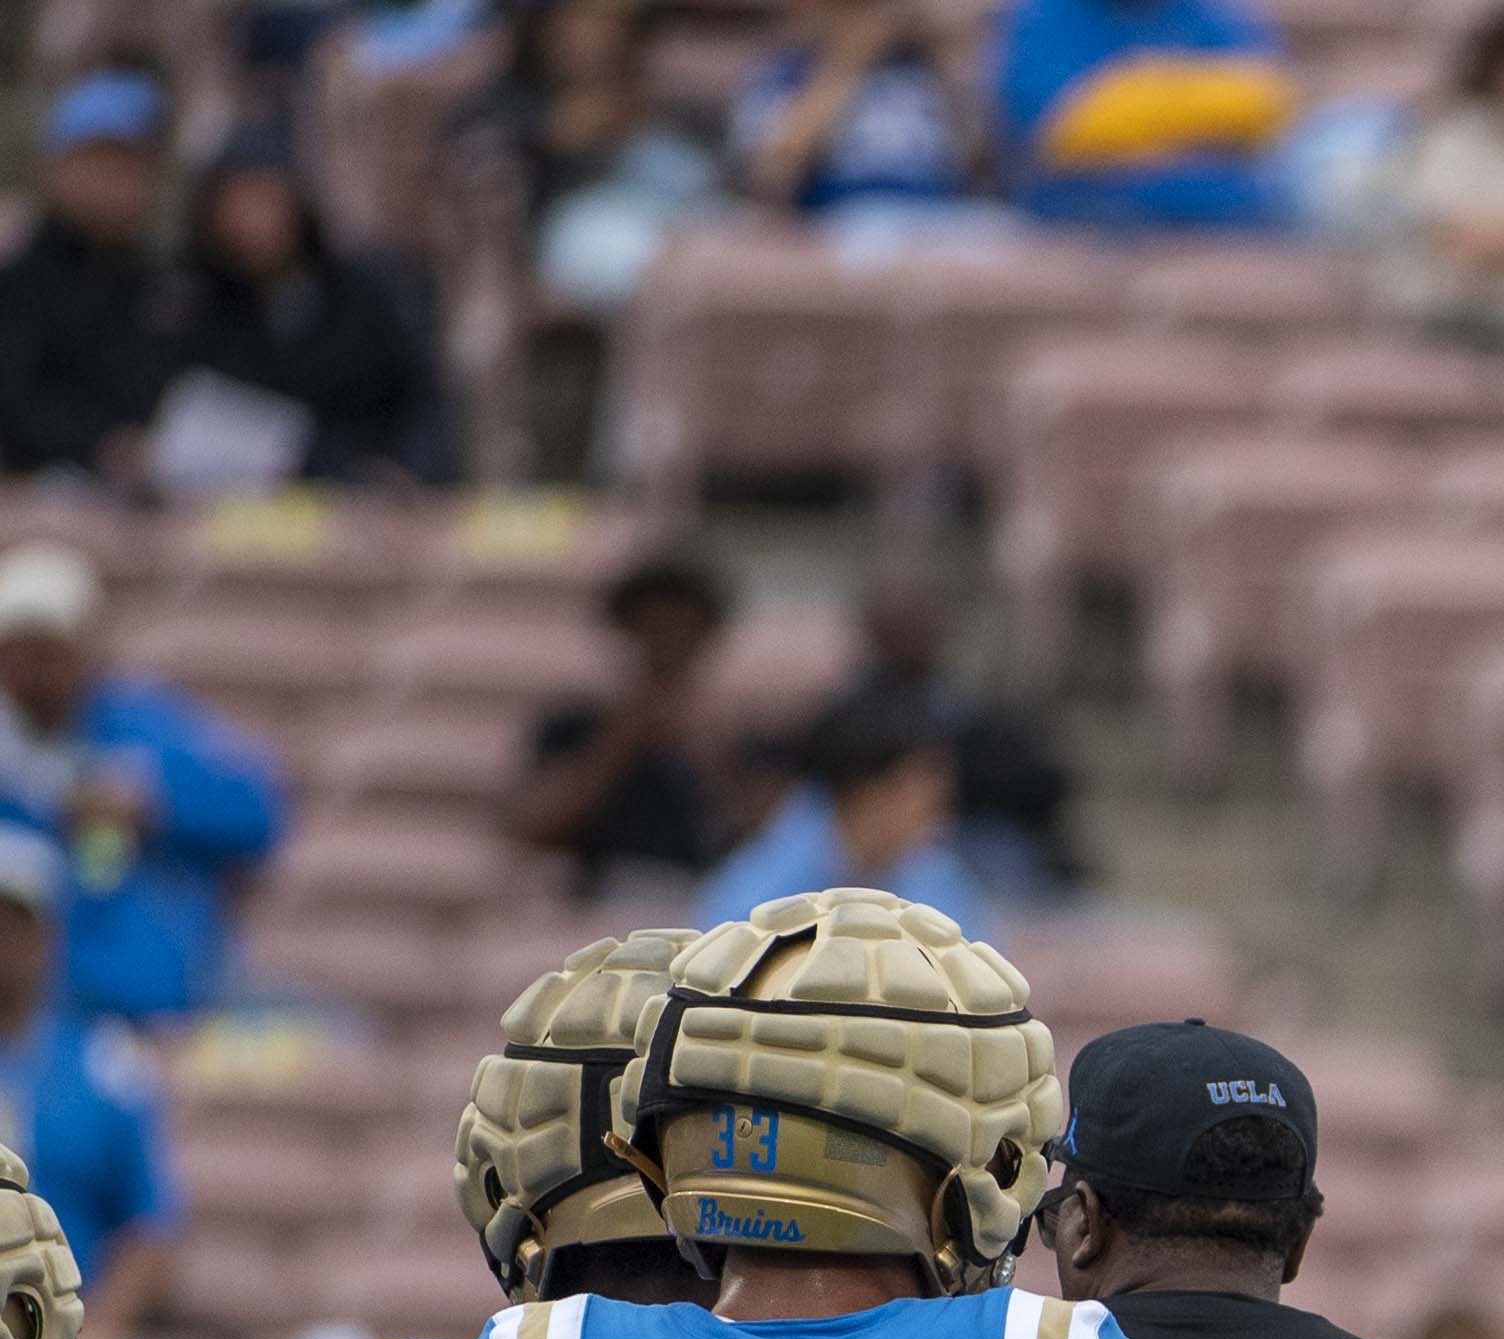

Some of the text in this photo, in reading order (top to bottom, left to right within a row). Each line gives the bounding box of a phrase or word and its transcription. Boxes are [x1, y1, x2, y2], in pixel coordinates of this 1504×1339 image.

[1206, 1081, 1287, 1107] UCLA
[711, 1104, 779, 1172] 33
[695, 1197, 806, 1243] Bruins
